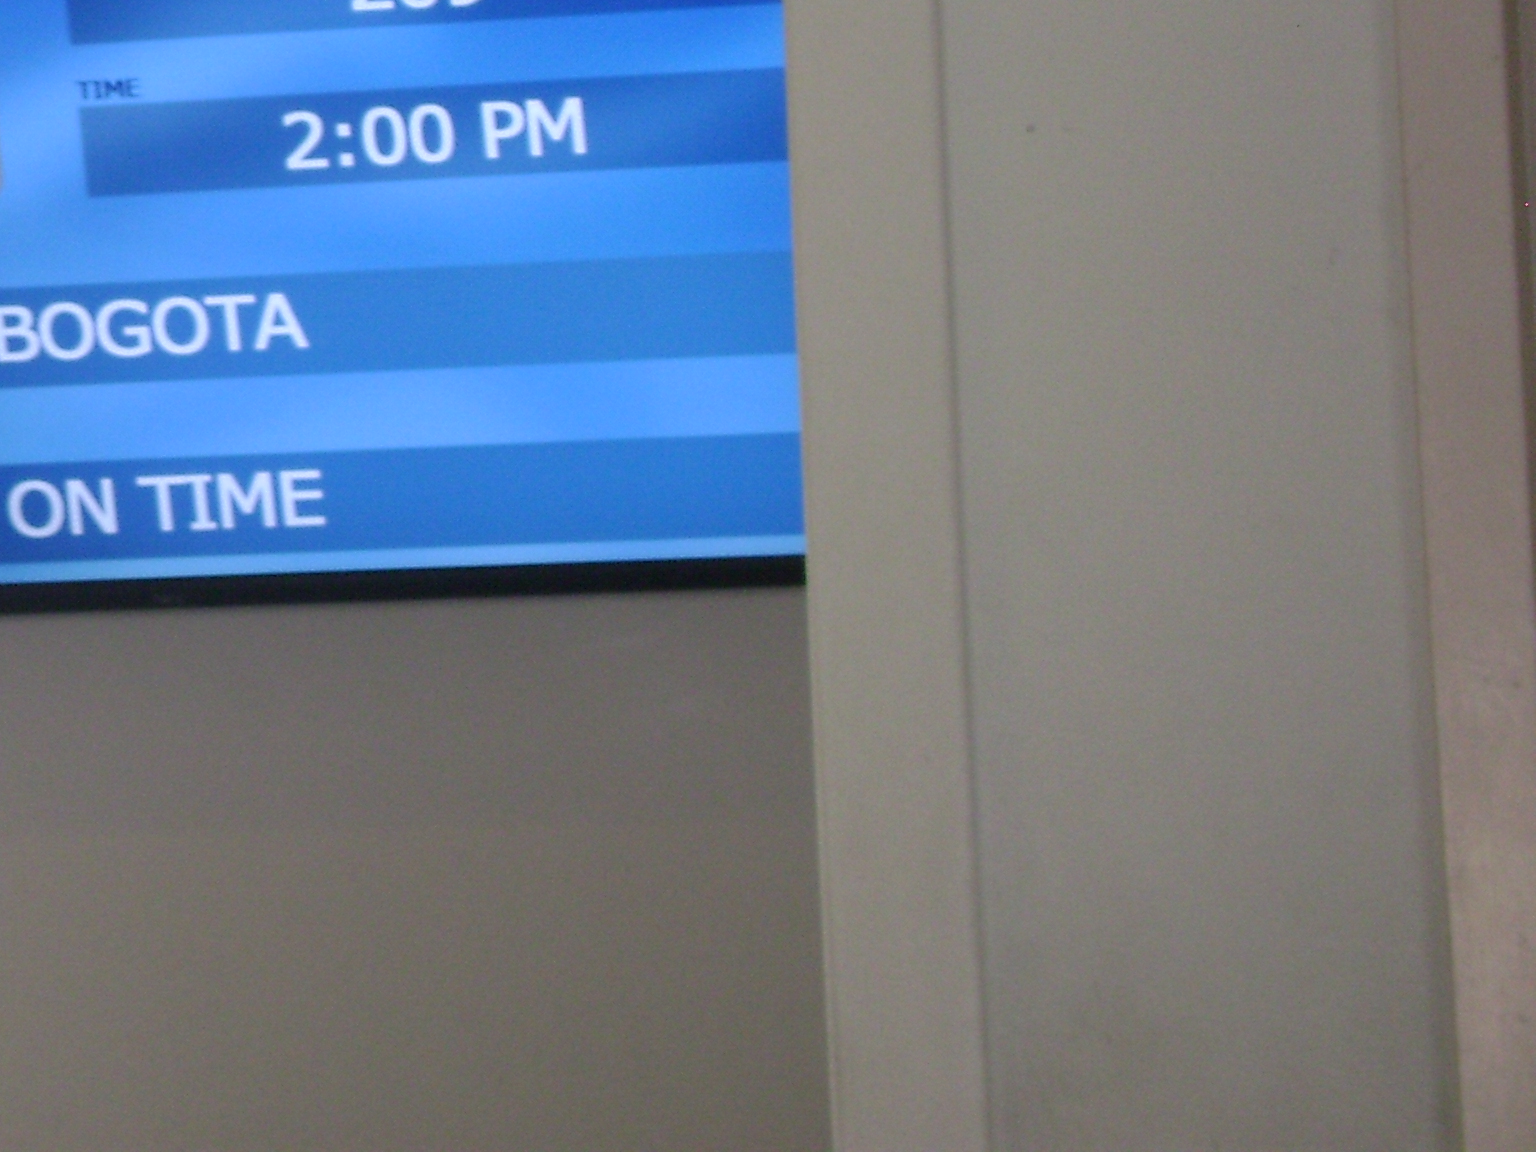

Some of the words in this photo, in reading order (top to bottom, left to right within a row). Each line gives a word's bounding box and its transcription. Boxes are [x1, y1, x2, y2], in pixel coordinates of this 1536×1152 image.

[77, 78, 141, 101] TIME
[281, 104, 456, 171] 2:00
[480, 96, 589, 160] PM
[5, 477, 119, 540] ON
[135, 470, 327, 532] TIME
